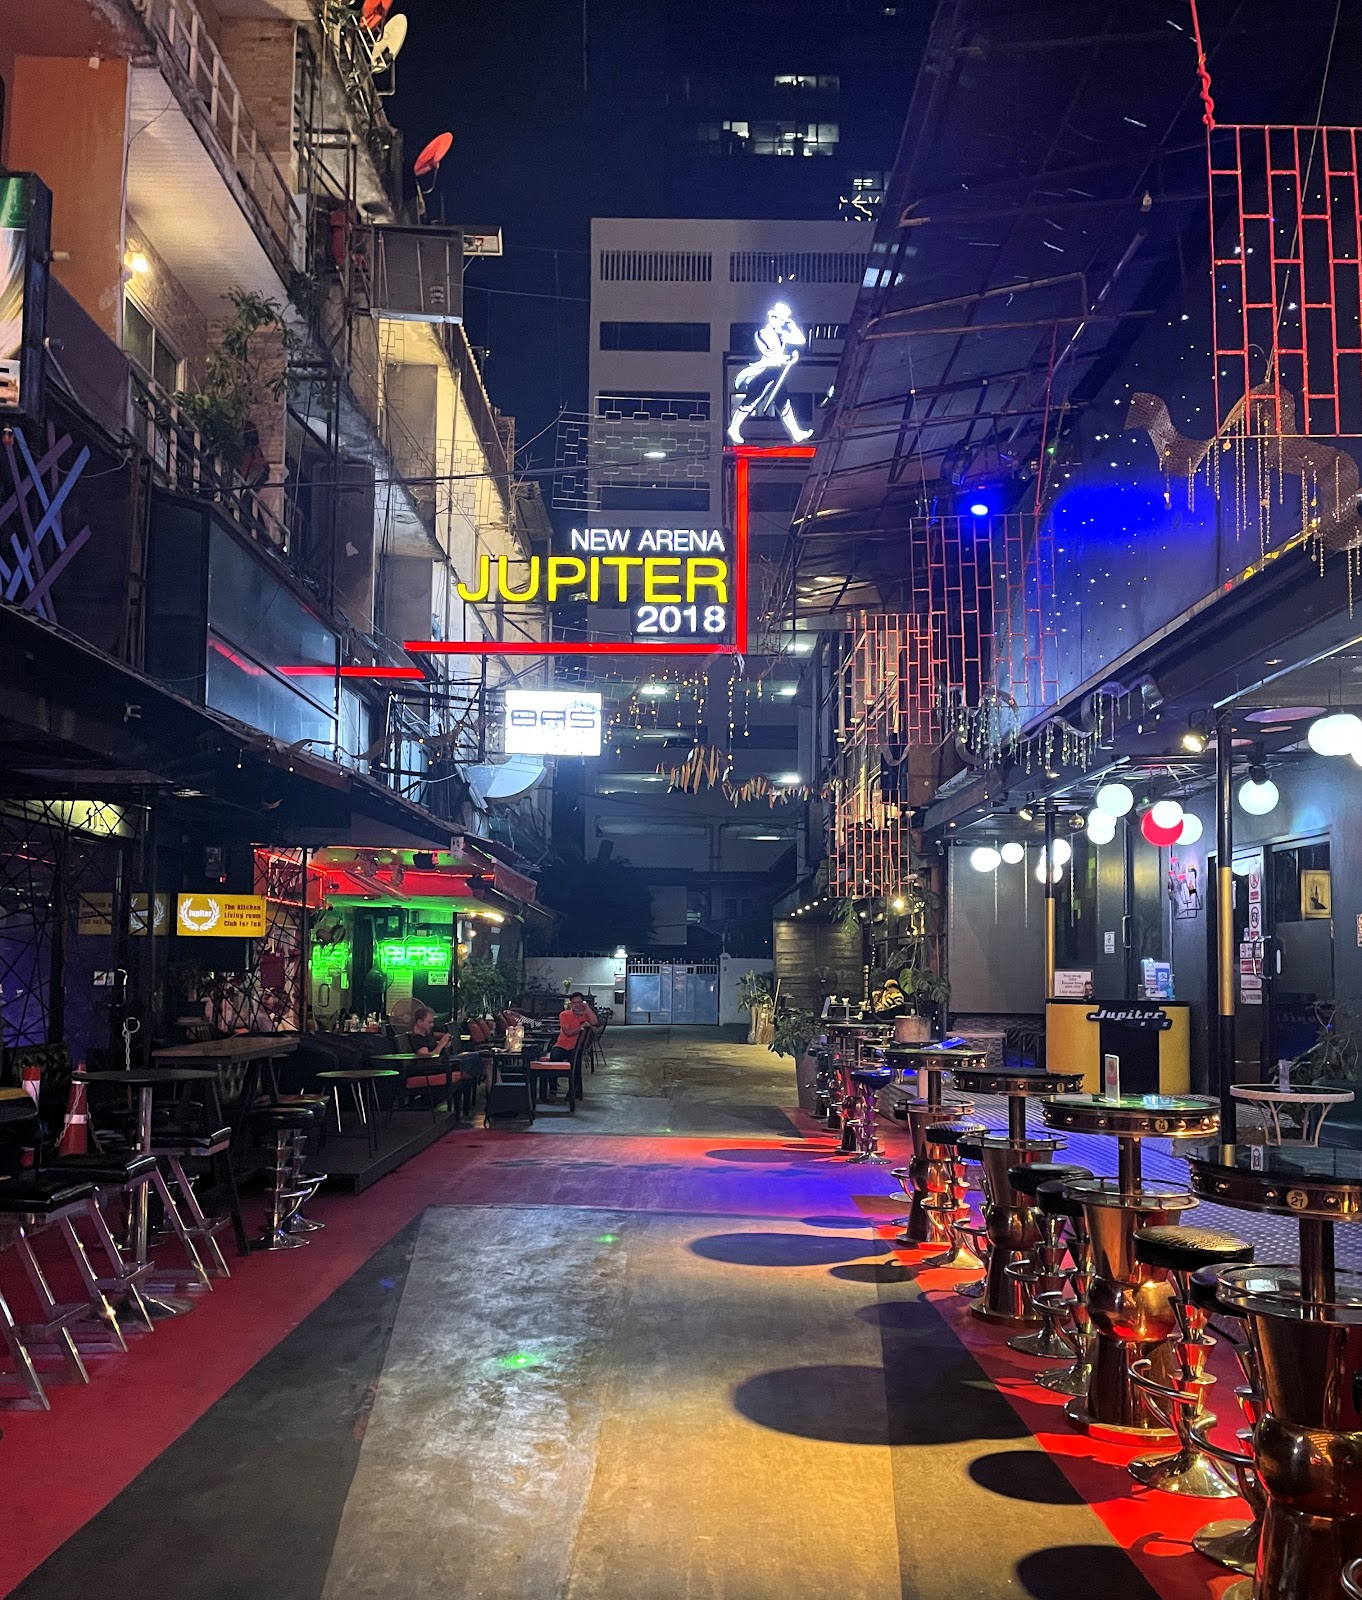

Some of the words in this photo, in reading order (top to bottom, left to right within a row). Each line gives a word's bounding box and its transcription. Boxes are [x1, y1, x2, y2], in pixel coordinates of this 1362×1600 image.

[571, 528, 631, 551] NEW
[637, 529, 726, 552] ARENA
[456, 554, 729, 603] JUPITER
[636, 604, 727, 634] 2018
[1089, 1009, 1164, 1021] Jupiter
[1290, 1196, 1304, 1208] 21
